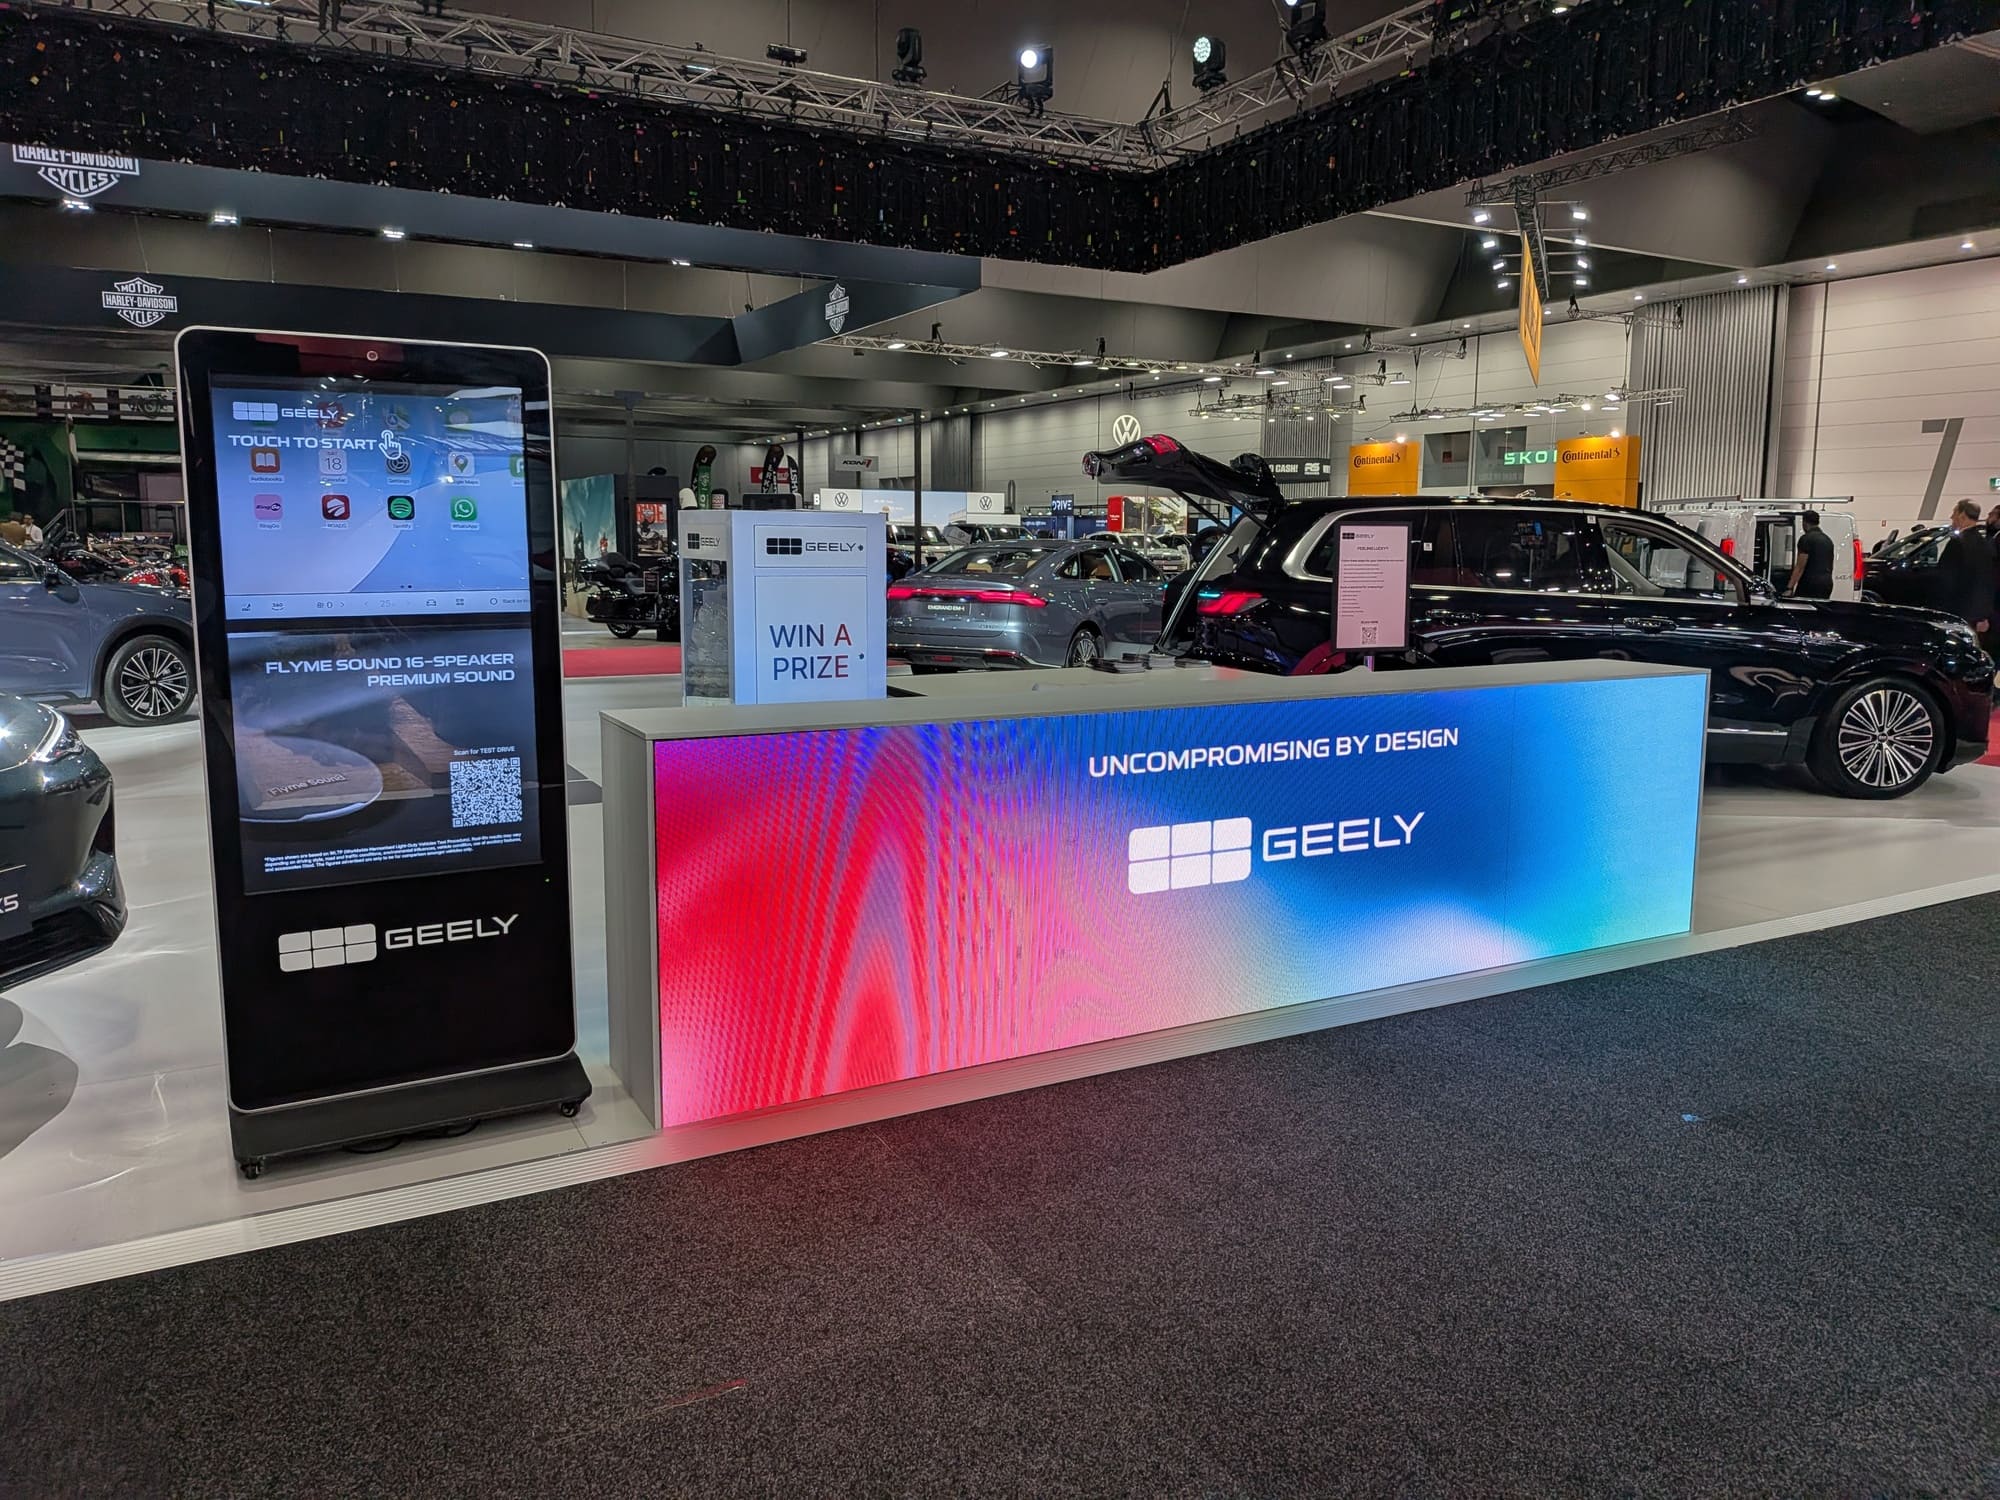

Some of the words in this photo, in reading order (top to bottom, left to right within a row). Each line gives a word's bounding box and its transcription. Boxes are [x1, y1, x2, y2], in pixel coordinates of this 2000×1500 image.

[19, 144, 133, 170] HARLEY-DAVIDSON
[48, 167, 108, 193] CYCLES
[120, 281, 158, 294] MOTOR
[106, 294, 174, 310] HARLEY-DAVIDSON
[124, 310, 159, 325] CYCLES
[281, 406, 339, 420] GEELY
[228, 434, 290, 448] TOUCH
[293, 436, 318, 448] TO
[320, 438, 377, 450] START
[1354, 453, 1394, 468] Continental
[1561, 448, 1612, 463] Continental
[326, 457, 342, 471] 18
[1275, 464, 1298, 473] CASH!
[1918, 417, 1964, 520] 7
[1052, 500, 1072, 511] DRIVE
[700, 536, 721, 547] GEELY
[805, 542, 857, 552] GEELY
[769, 623, 824, 648] WIN
[834, 623, 852, 646] A
[266, 660, 332, 674] FLYME
[336, 657, 402, 671] SOUND
[405, 653, 514, 668] 16-SPEAKER
[773, 655, 849, 680] PRIZE
[367, 673, 451, 687] PREMIUM
[454, 669, 515, 683] SOUND
[496, 745, 515, 753] DRIVE
[1089, 738, 1330, 778] UNCOMPROMISING
[1336, 735, 1370, 757] BY
[1375, 727, 1459, 753] DESIGN
[268, 782, 308, 796] Flyme
[308, 773, 347, 786] Sound
[1263, 811, 1425, 862] GEELY
[385, 913, 519, 950] GEELY
